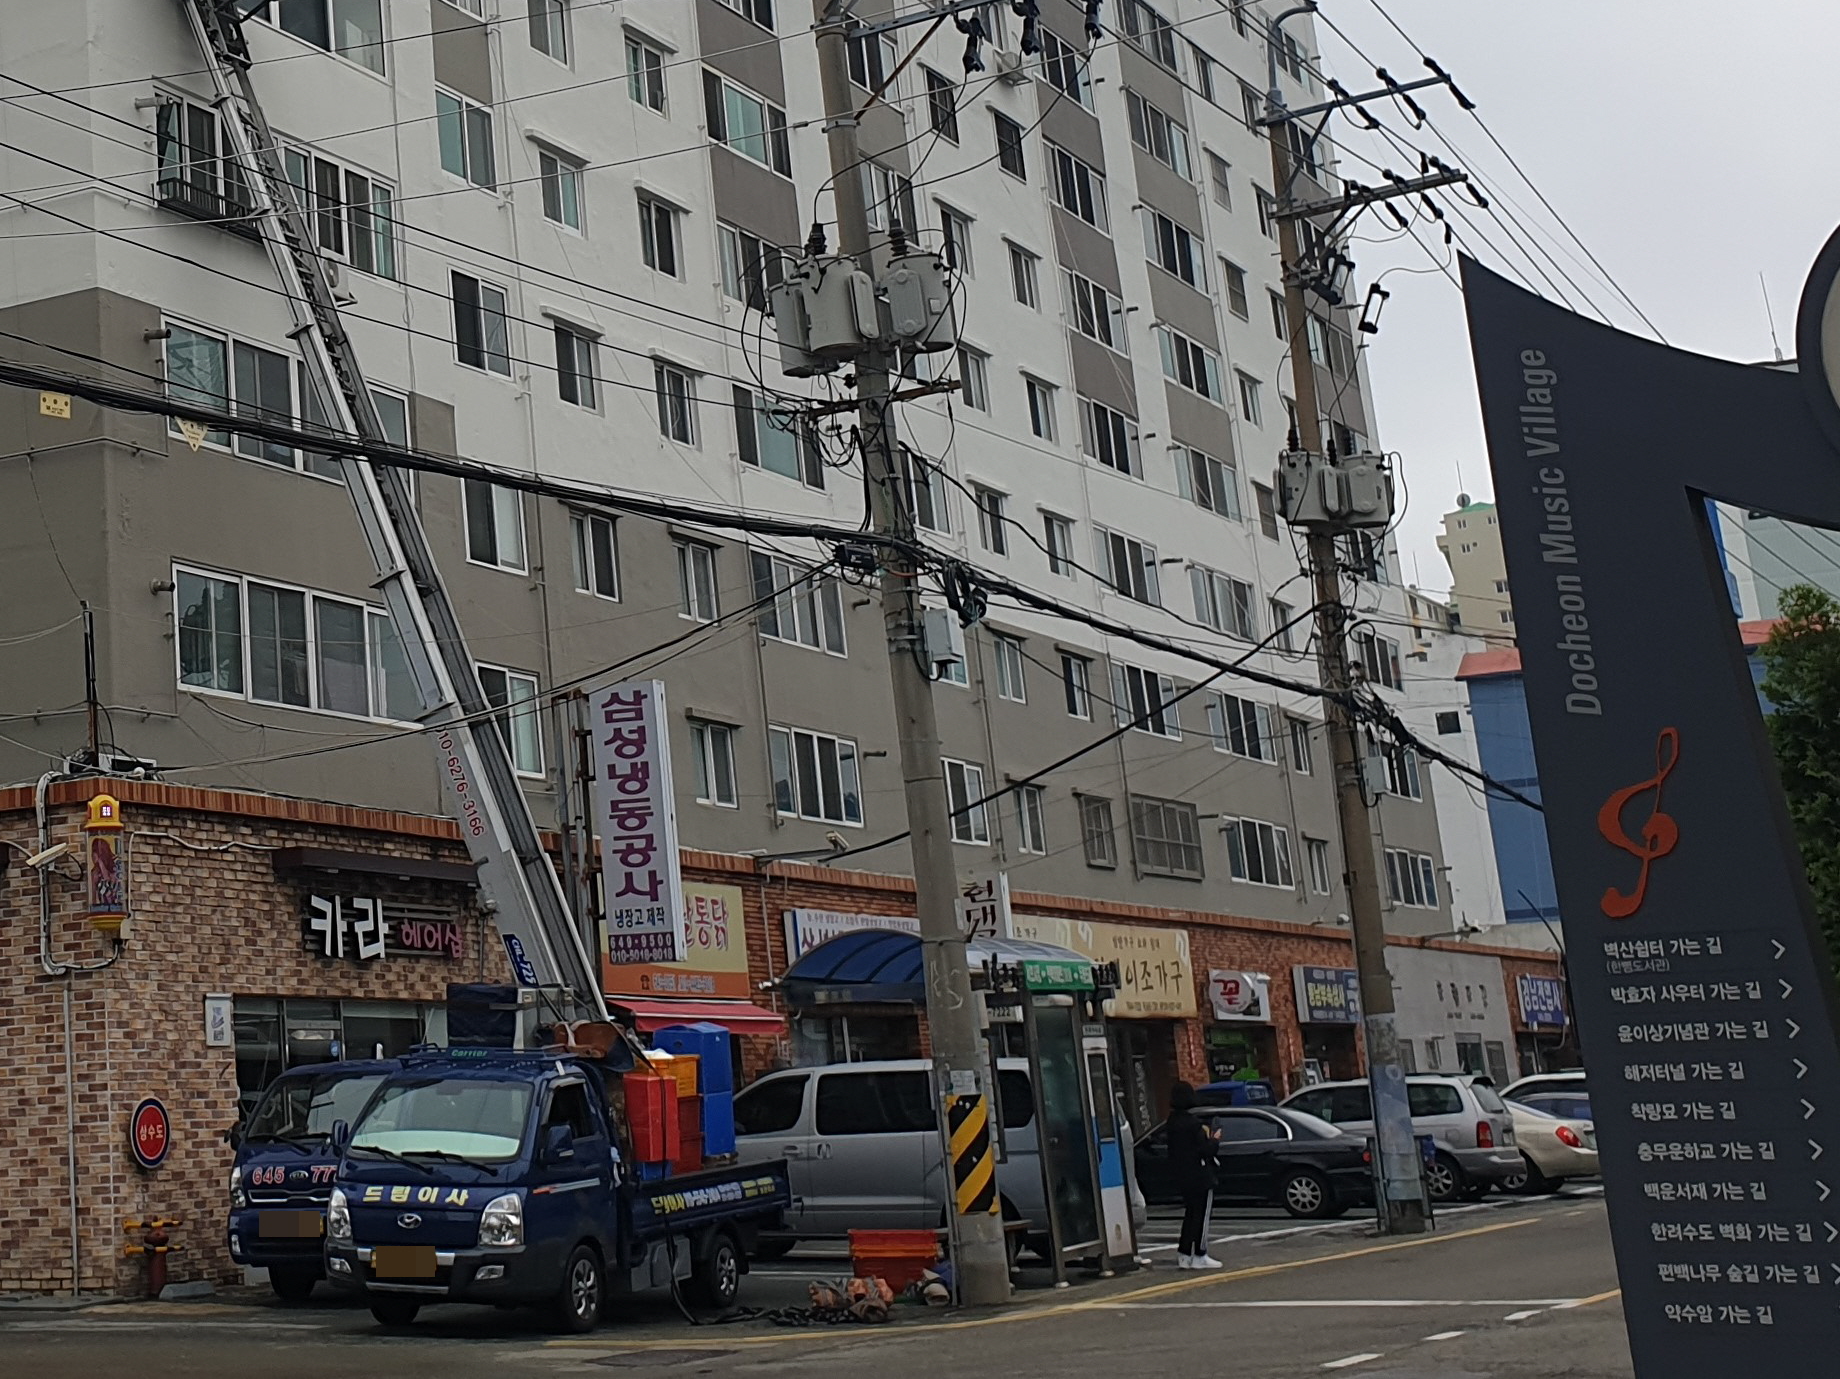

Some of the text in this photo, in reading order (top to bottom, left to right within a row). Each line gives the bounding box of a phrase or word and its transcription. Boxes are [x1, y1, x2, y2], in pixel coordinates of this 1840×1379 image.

[1520, 349, 1602, 717] Docheon Music Village
[601, 689, 664, 903] 삼성냉동공사
[311, 894, 389, 960] 카라
[615, 906, 665, 929] 냉장고 제작
[1669, 938, 1701, 956] 가는
[1706, 936, 1722, 955] 길
[1610, 985, 1657, 1004] 박효자
[1709, 982, 1741, 1000] 가는
[1745, 981, 1762, 999] 길
[1617, 1020, 1769, 1043] 윤이상기념관 가는 길
[1624, 1061, 1745, 1082] 해저터널 가는 길
[1682, 1102, 1715, 1120] 가는
[1719, 1101, 1736, 1120] 길
[1637, 1140, 1776, 1161] 충무운하교 가는 길
[252, 1166, 285, 1185] 645
[363, 1185, 469, 1206] 드림이사
[1643, 1181, 1767, 1201] 백운서재 가는 길
[1651, 1222, 1813, 1242] 한려수도 벽화 가는 길
[1658, 1263, 1821, 1284] 편백나무 숲길 가는 길
[1664, 1304, 1774, 1324] 약수암 가는 길
